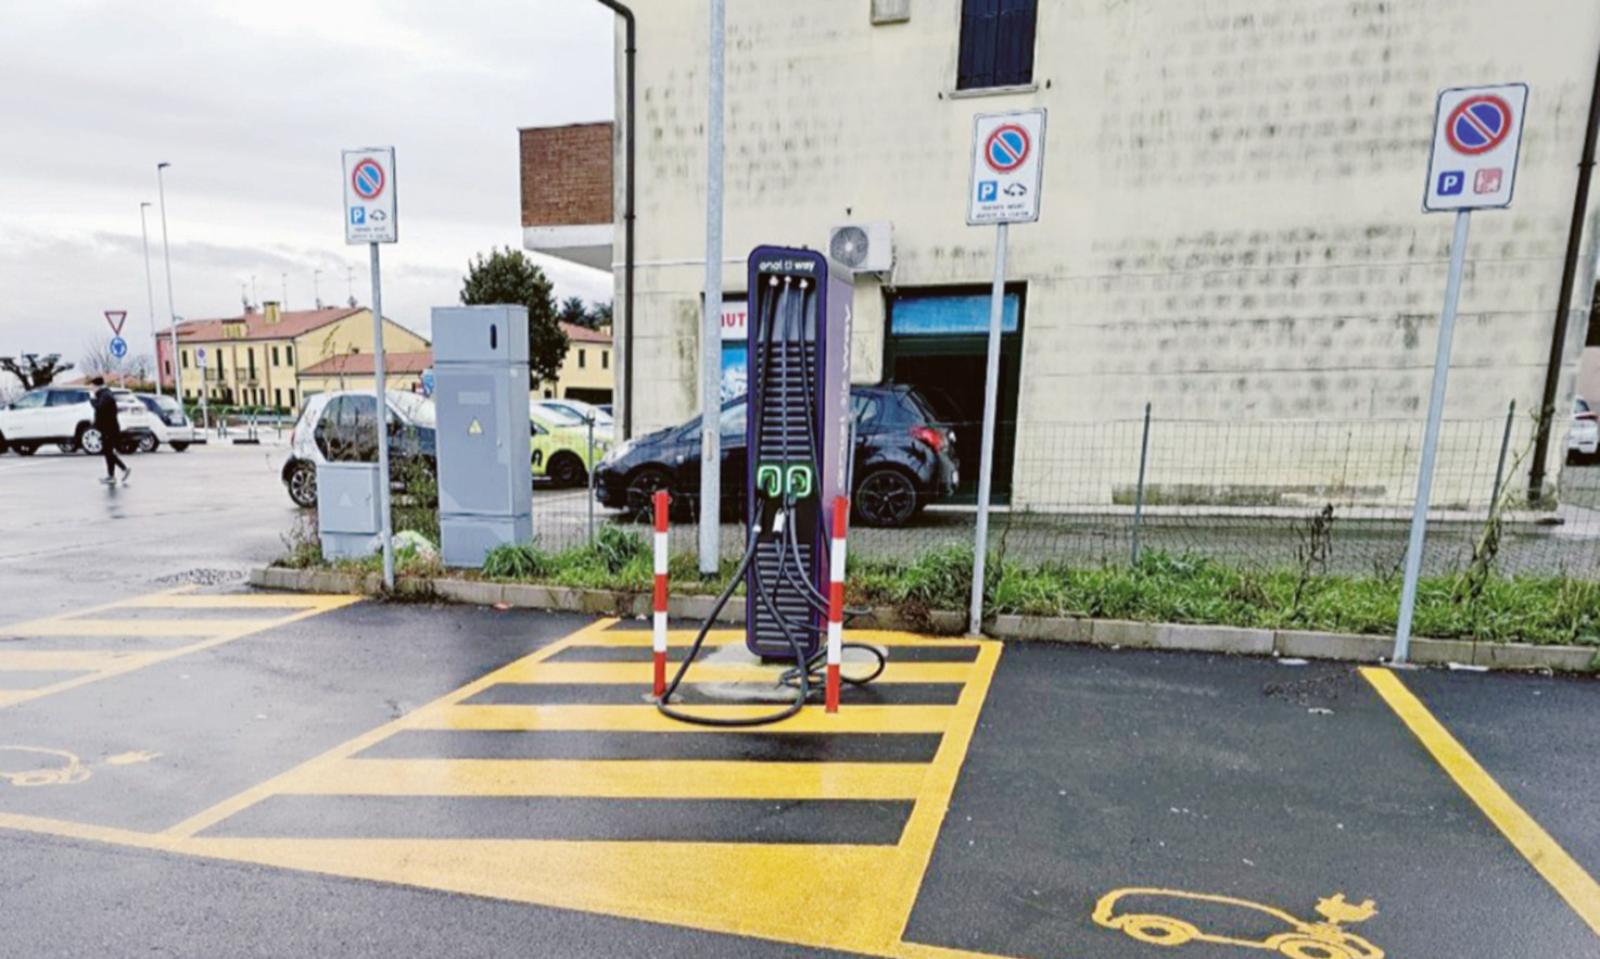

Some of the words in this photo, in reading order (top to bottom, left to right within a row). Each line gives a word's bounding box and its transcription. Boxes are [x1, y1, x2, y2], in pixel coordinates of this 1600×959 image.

[981, 183, 995, 200] P
[1443, 175, 1458, 192] P
[794, 261, 816, 272] way
